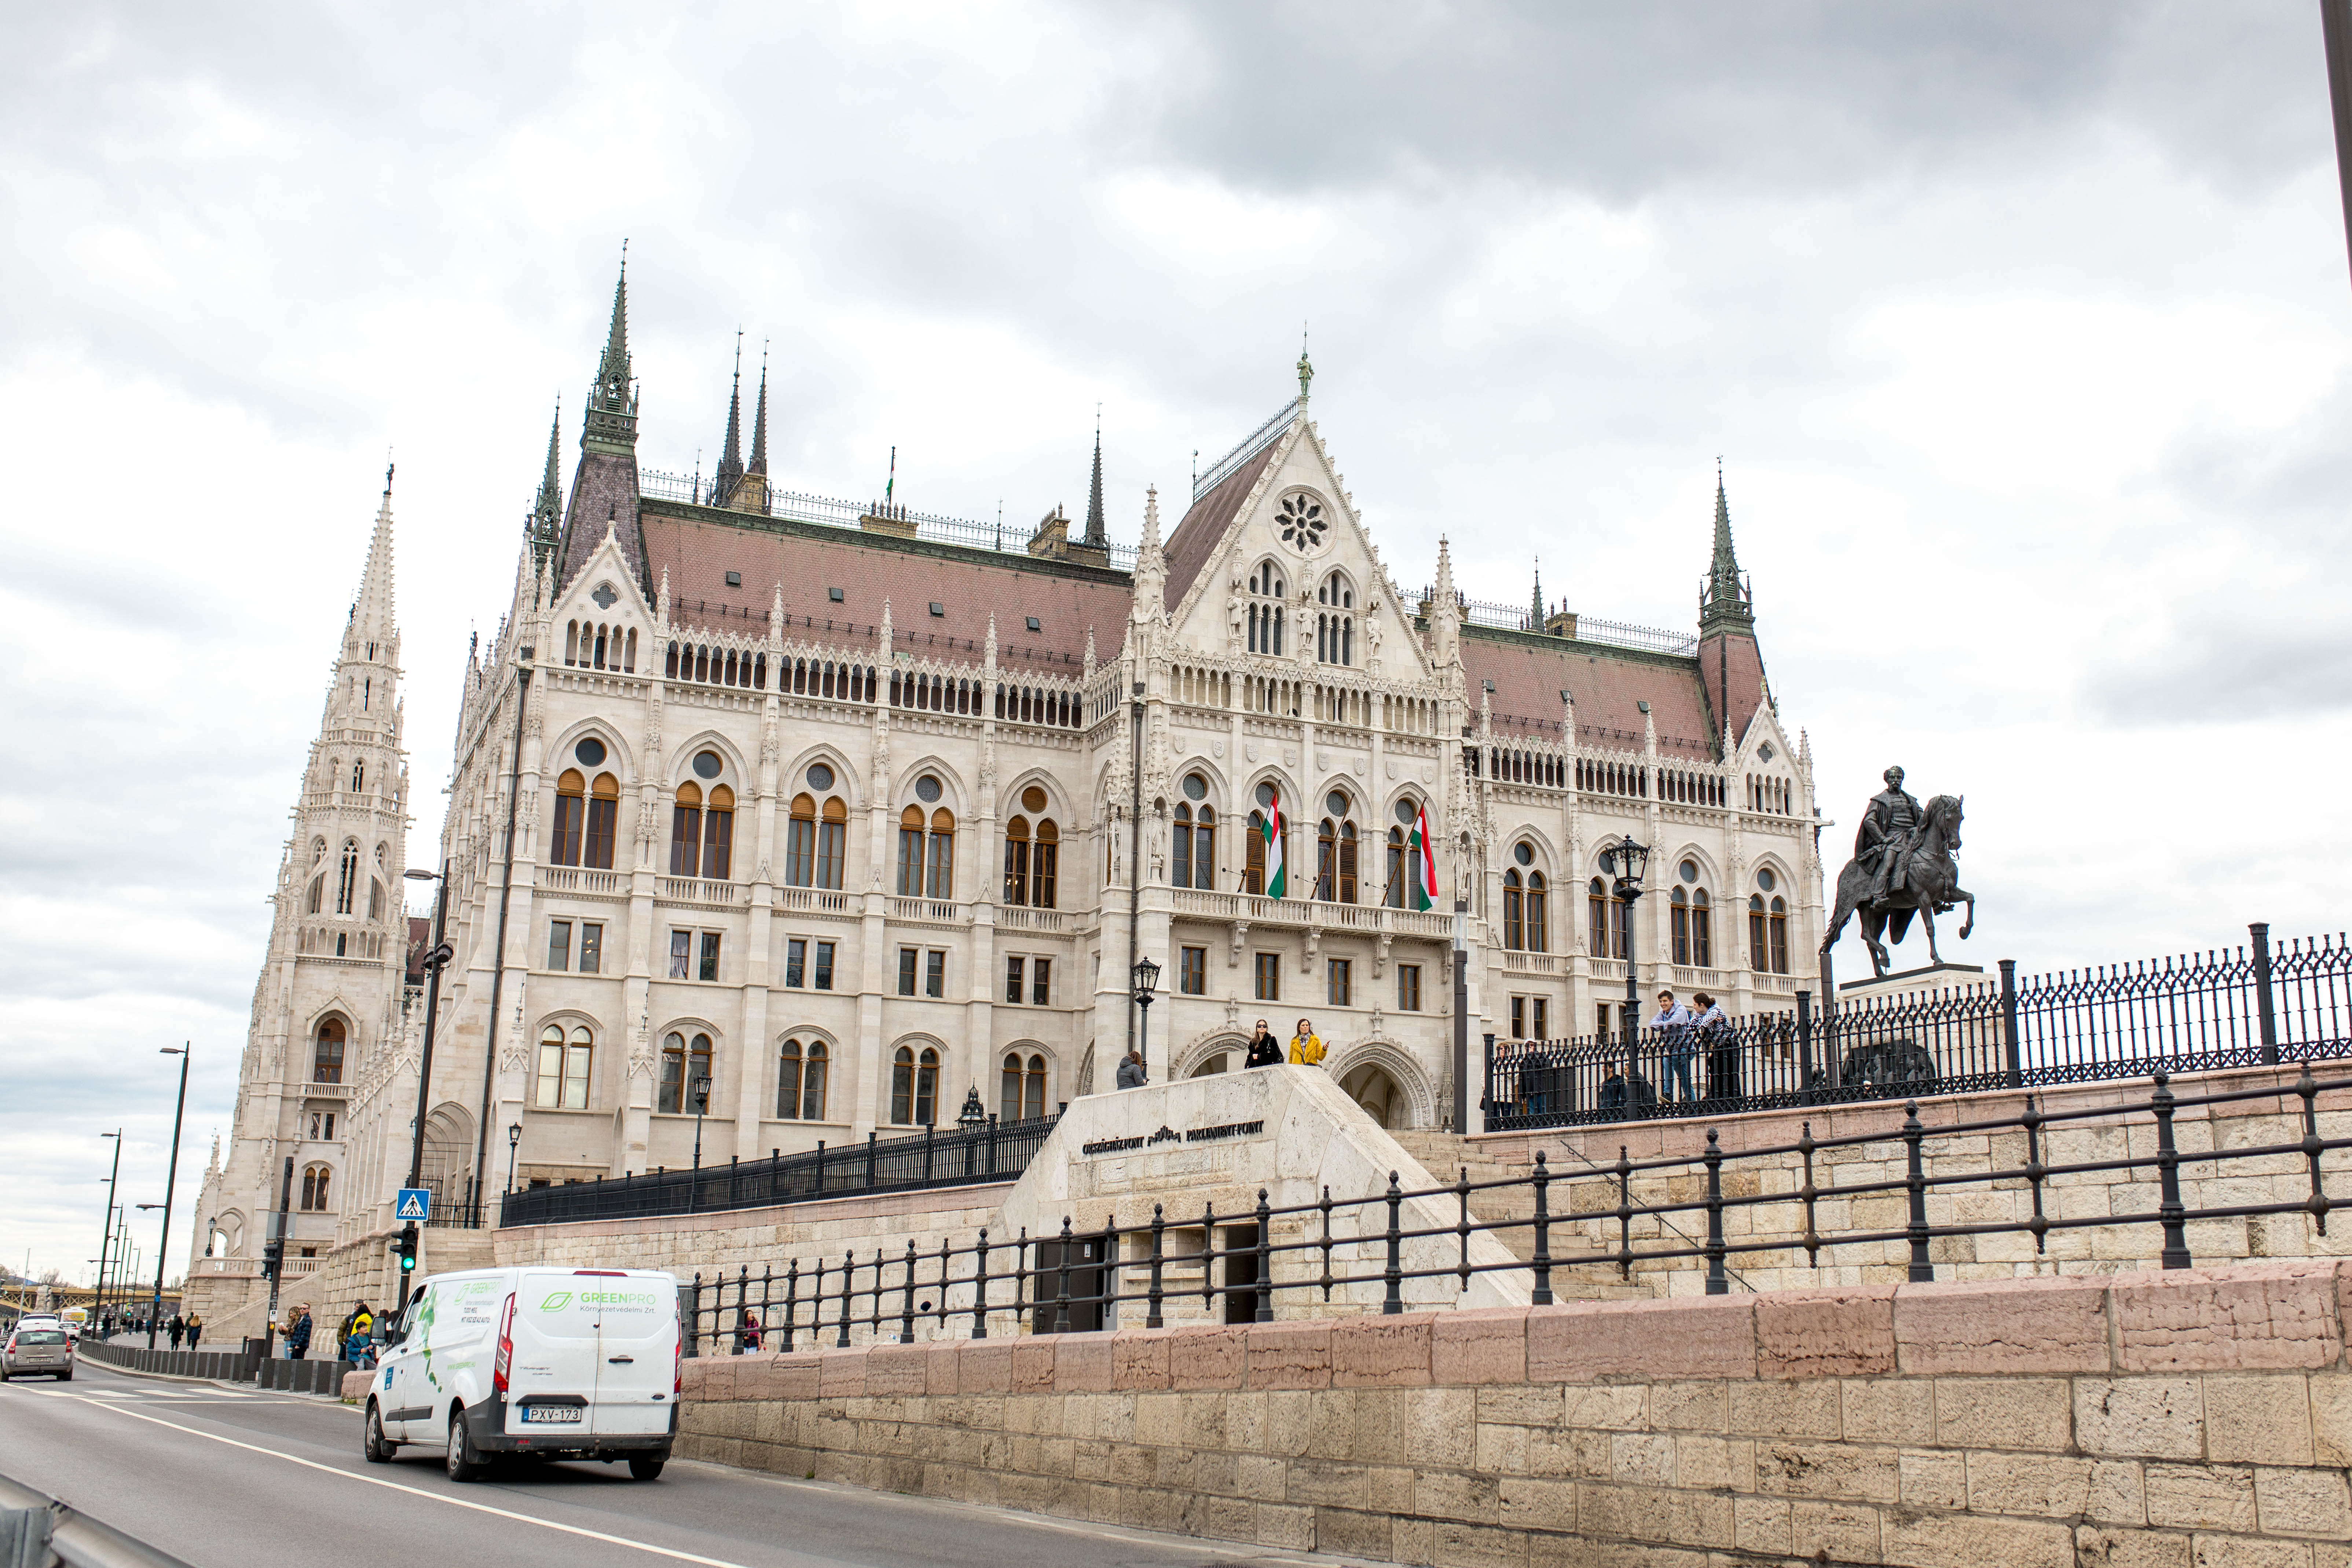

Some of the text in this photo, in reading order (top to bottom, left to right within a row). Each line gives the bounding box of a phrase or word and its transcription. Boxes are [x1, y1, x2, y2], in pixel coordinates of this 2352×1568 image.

[470, 1282, 501, 1294] GREENPRO
[580, 1293, 656, 1304] GREENPRO
[531, 1410, 578, 1419] PXV-173
